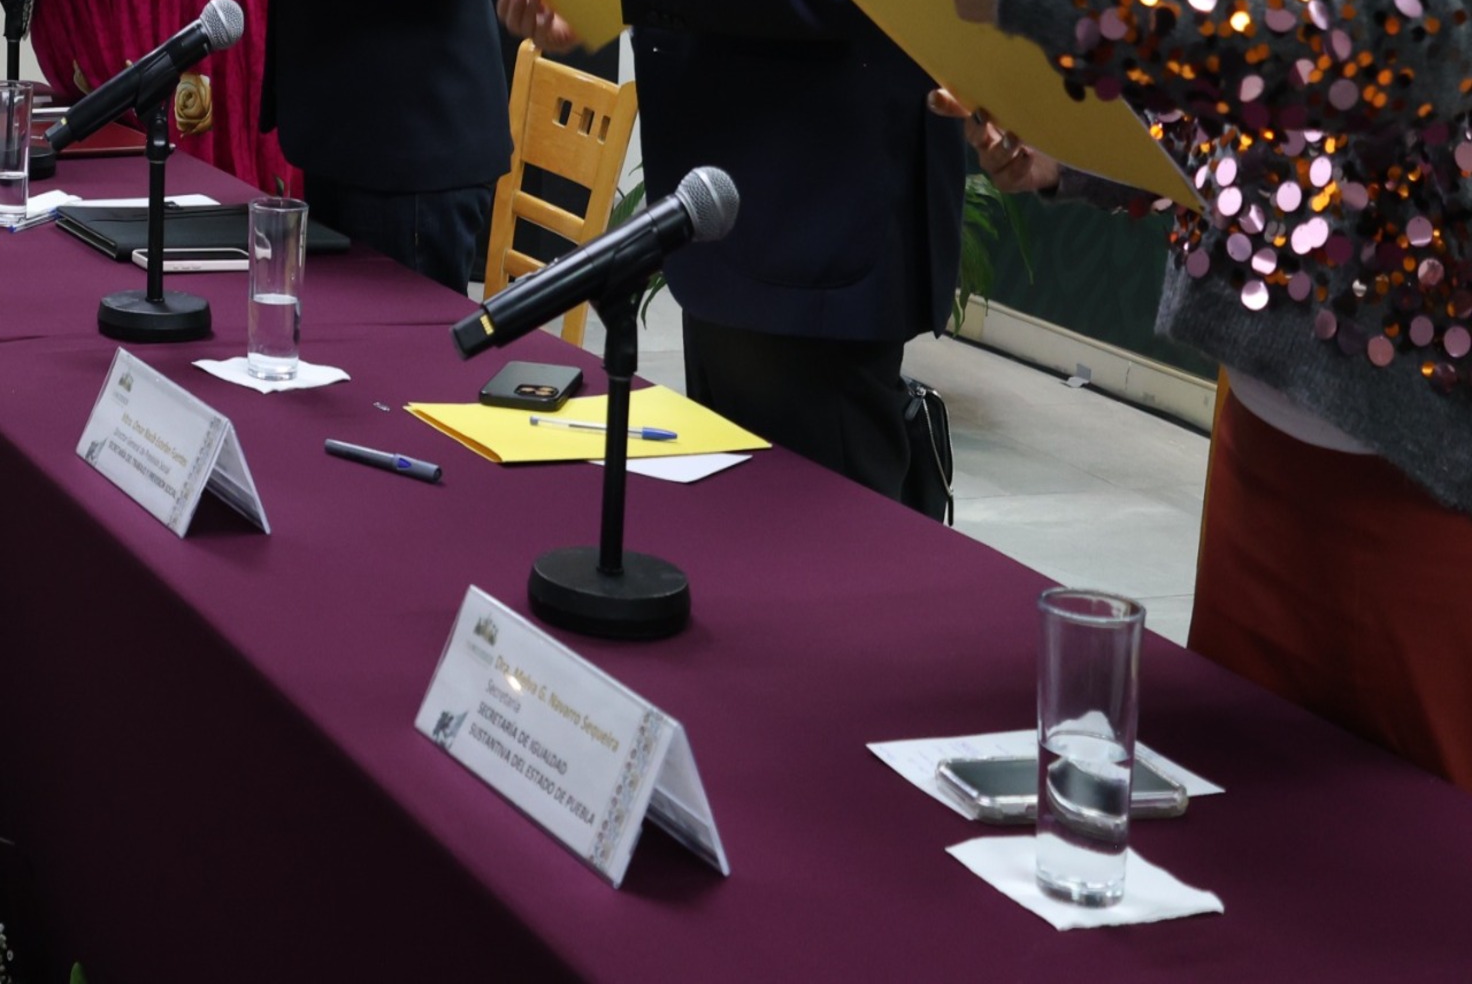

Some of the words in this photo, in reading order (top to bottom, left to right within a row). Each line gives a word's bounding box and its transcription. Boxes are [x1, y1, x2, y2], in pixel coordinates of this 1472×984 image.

[477, 701, 518, 740] SECRETARÍA
[517, 730, 530, 749] DE
[529, 739, 567, 776] IGUALDAD
[549, 691, 581, 726] Navarro
[581, 714, 620, 753] Sequeira
[468, 722, 511, 764] SUSTANTIVA
[510, 753, 526, 775] DEL
[525, 765, 555, 795] ESTADO
[554, 786, 566, 805] DE
[566, 795, 596, 826] PUEBLA
